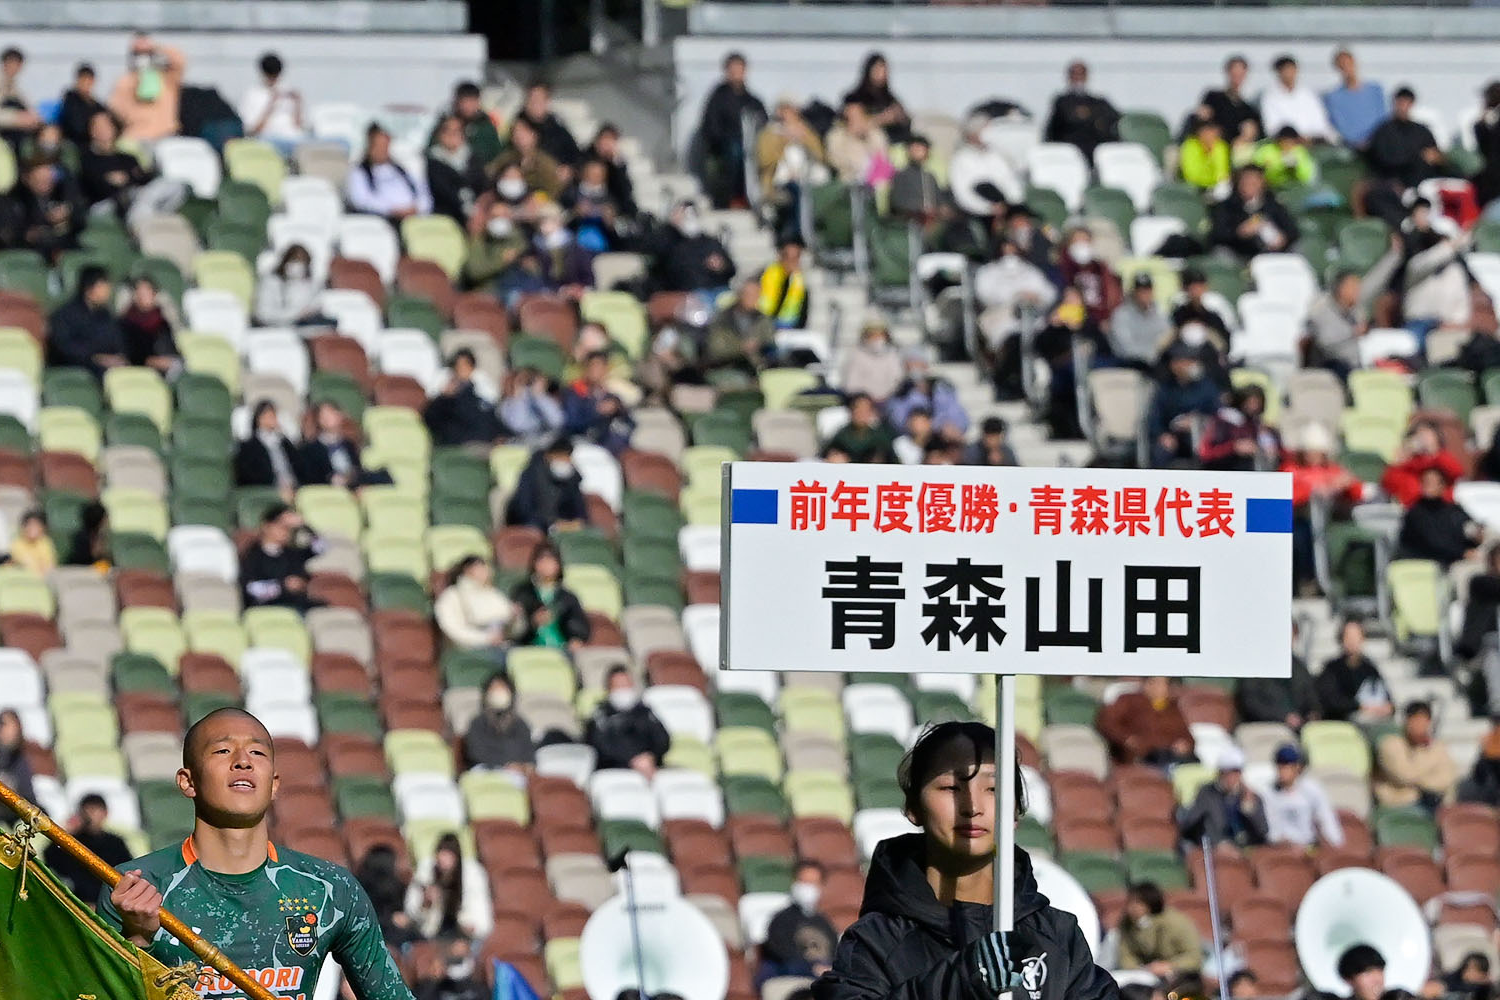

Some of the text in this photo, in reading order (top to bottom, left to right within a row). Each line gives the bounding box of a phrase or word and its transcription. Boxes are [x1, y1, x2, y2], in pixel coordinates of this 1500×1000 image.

[789, 480, 1235, 538] 前年度優勝・青森県代表
[821, 555, 1202, 654] 青森山田
